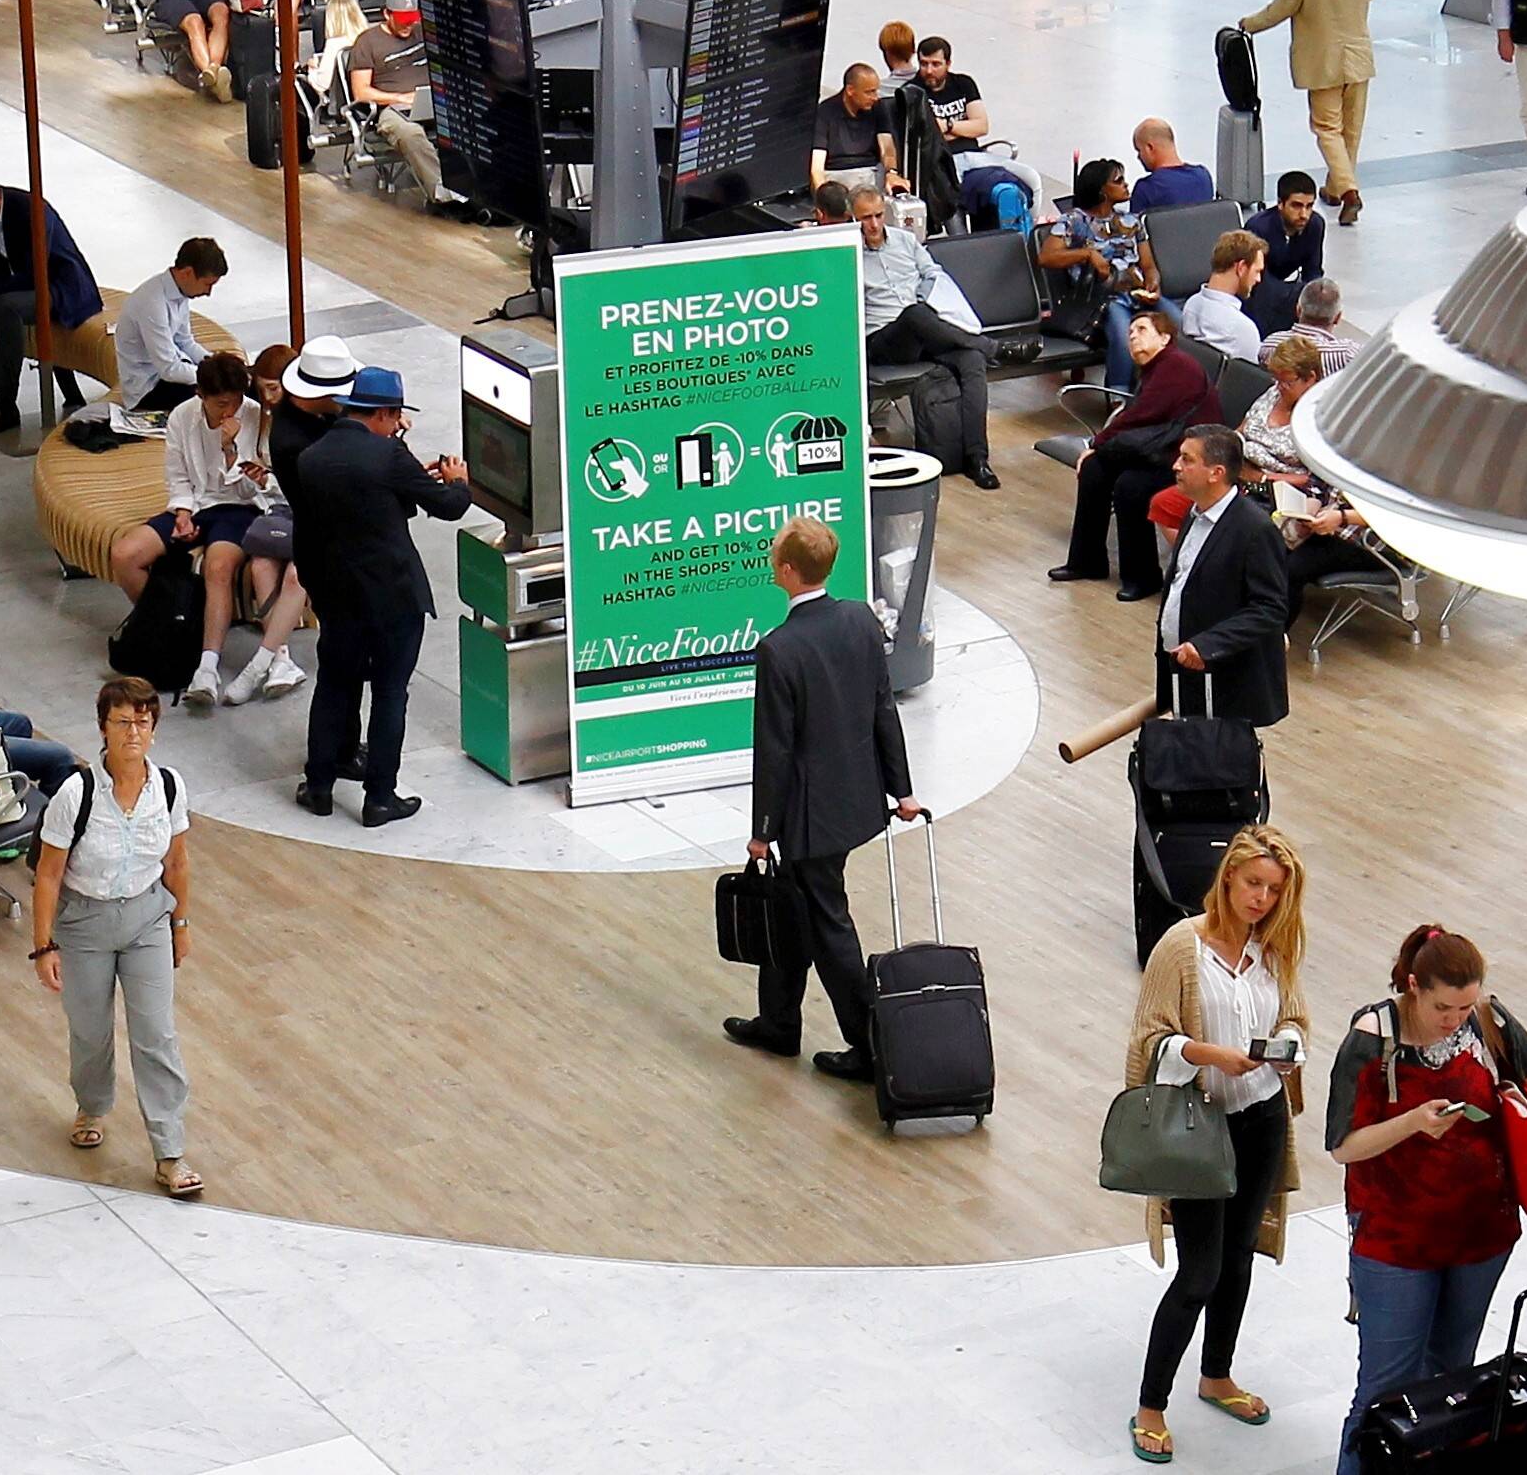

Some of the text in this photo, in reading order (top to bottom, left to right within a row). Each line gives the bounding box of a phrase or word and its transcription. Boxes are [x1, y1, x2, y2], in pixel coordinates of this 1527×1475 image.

[600, 283, 819, 330] PRENEZ-VOUS
[632, 316, 790, 357] EN PHOTO
[604, 344, 814, 380] ET PROFITEZ DE -10% DANS
[624, 381, 651, 396] LES
[756, 364, 796, 380] AVEC
[585, 377, 841, 418] LE HASHTAG #NICEFOOTBALLFAN
[653, 447, 838, 464] OU -10%
[653, 463, 669, 474] OR
[592, 498, 843, 551] TAKE A PICTURE
[651, 549, 684, 564] AND
[689, 545, 719, 560] GET
[724, 540, 753, 556] 10%
[624, 571, 639, 585] IN
[644, 567, 673, 582] THE
[603, 585, 675, 606] HASHTAG
[661, 663, 678, 672] LIVE
[682, 660, 697, 669] THE
[700, 657, 732, 667] SOCCER
[623, 669, 754, 693] DU 10 JUIN AU 10 JUILLET JUNE
[586, 739, 707, 764] #NICEAIRPORTSHOPPING
